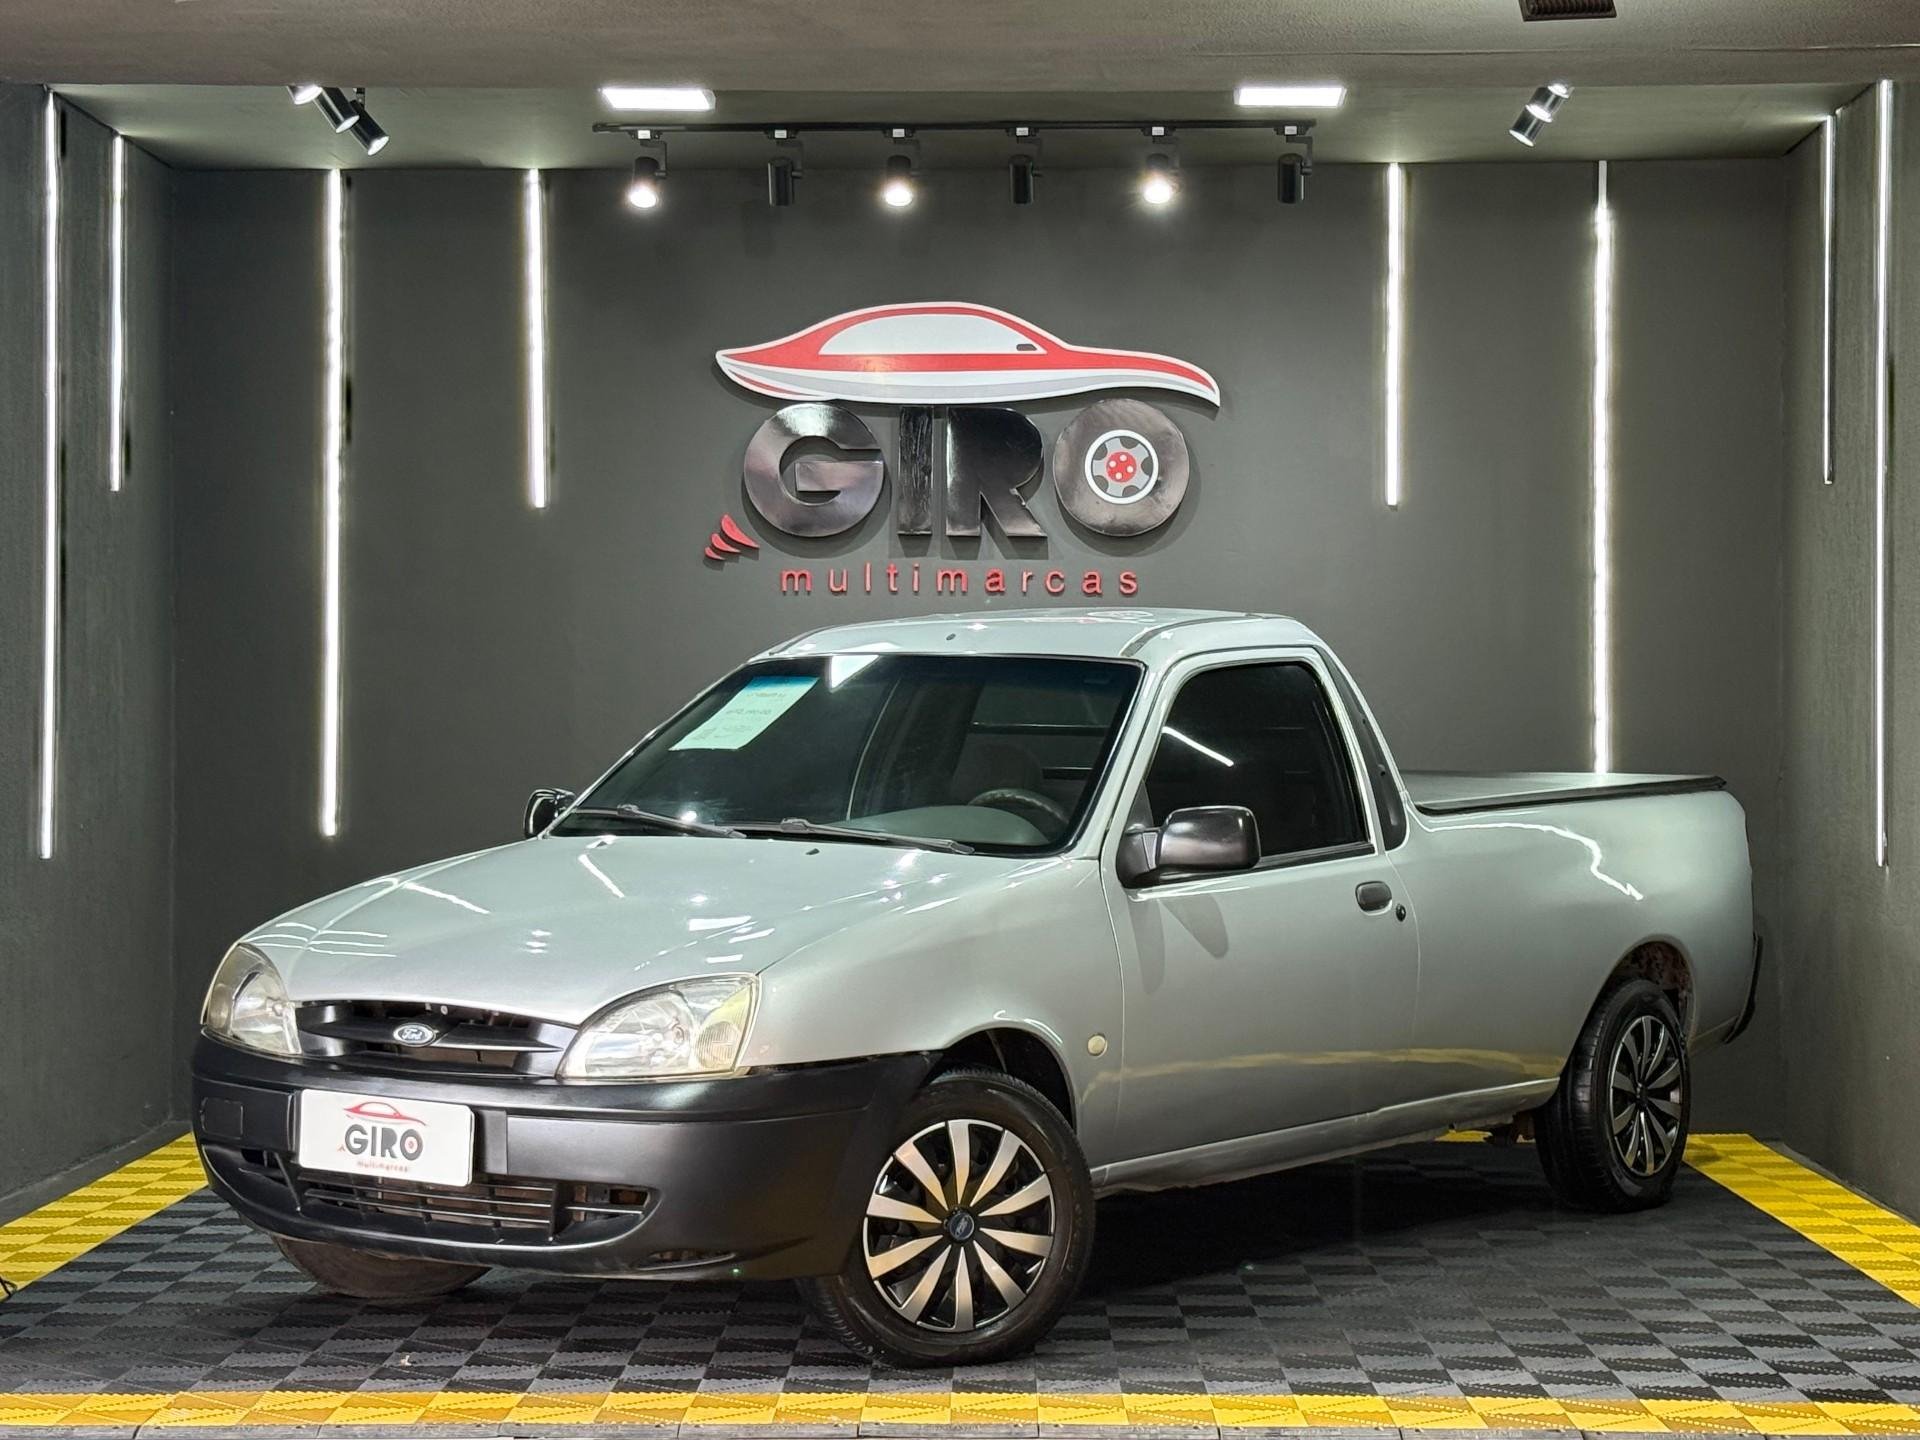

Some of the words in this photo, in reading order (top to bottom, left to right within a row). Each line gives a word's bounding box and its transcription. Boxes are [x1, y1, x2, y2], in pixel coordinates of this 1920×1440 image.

[744, 400, 1189, 536] GIRO
[780, 562, 1139, 595] multimarcas
[345, 1124, 423, 1160] GIRO
